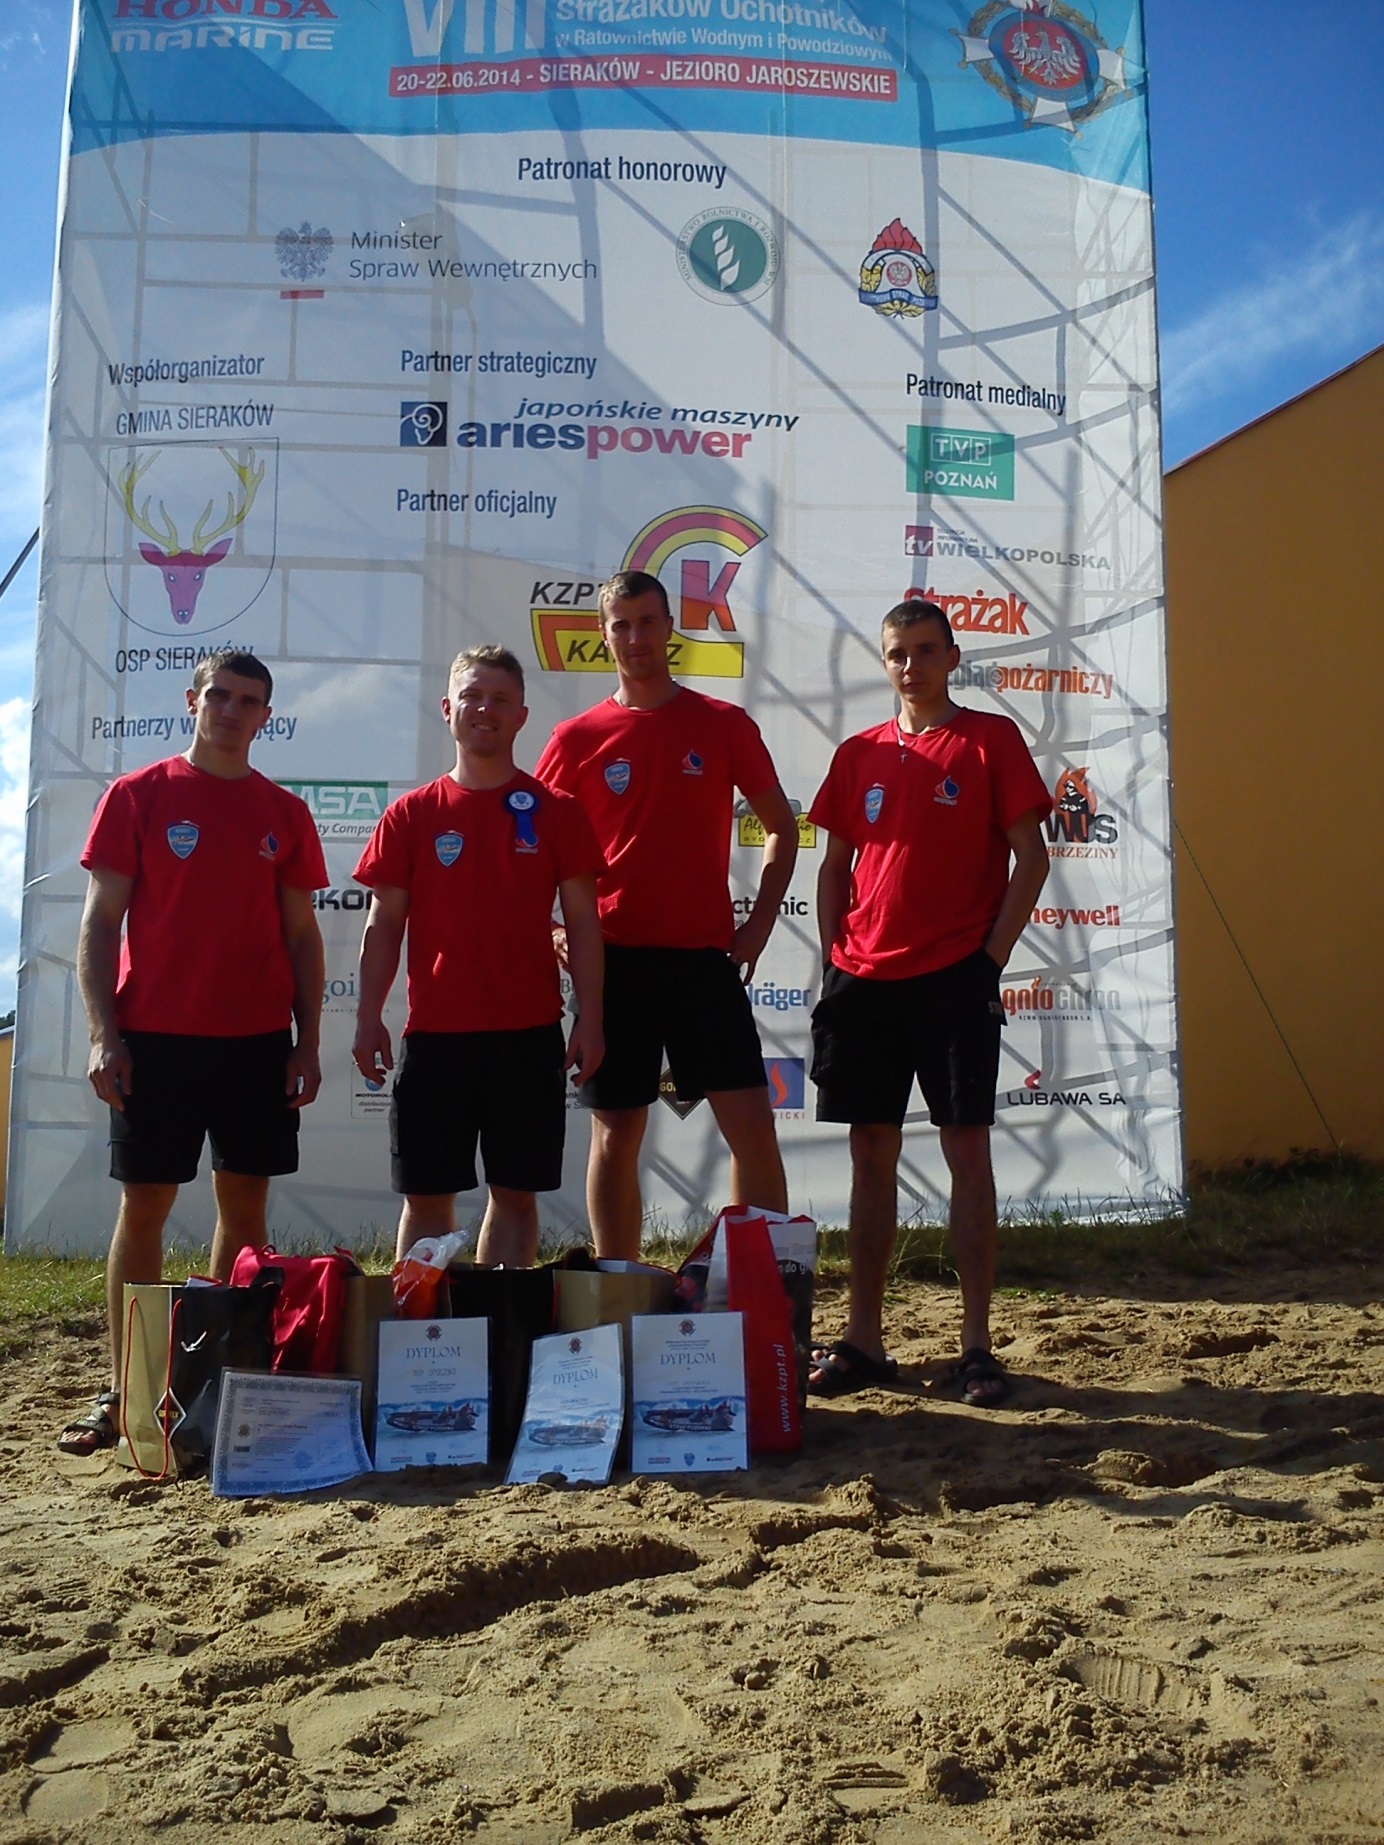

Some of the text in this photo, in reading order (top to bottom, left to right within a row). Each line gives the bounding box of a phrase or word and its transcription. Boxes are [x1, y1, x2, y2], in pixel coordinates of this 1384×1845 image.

[112, 0, 339, 20] HONDA
[404, 0, 547, 57] VIII
[555, 27, 893, 62] w Ratownictwie Wodnym i Powodziowym
[396, 68, 522, 92] 20-22.06.2014
[539, 58, 641, 83] SIERAKÓW
[660, 60, 740, 83] JEZIORO
[745, 64, 892, 94] JAROSZEWSKIE
[518, 156, 727, 189] Patronat honorowy
[351, 230, 443, 250] Minister
[349, 258, 597, 282] Spraw Wewnętrznych
[108, 354, 265, 388] Współorganizator
[401, 350, 597, 379] Partner strategiczny
[906, 373, 1067, 416] Patronat medialny
[116, 399, 274, 435] GMINA SIERAKÓW
[513, 397, 800, 432] japońskie maszyny
[933, 437, 989, 463] TVP
[923, 470, 998, 490] POZNAŃ
[396, 488, 558, 520] Partner oficjalny
[936, 542, 1112, 570] WIELKOPOLSKA
[529, 582, 602, 606] KZP
[115, 649, 151, 673] OSP
[92, 715, 175, 741] Partnerzy
[1047, 846, 1119, 859] BRZEZINY
[1029, 905, 1121, 930] neywell
[1006, 1092, 1127, 1106] LUBAWA SA
[406, 1345, 461, 1360] DYPLOM
[660, 1352, 717, 1366] DYPLOM
[552, 1368, 599, 1385] DYPLOM
